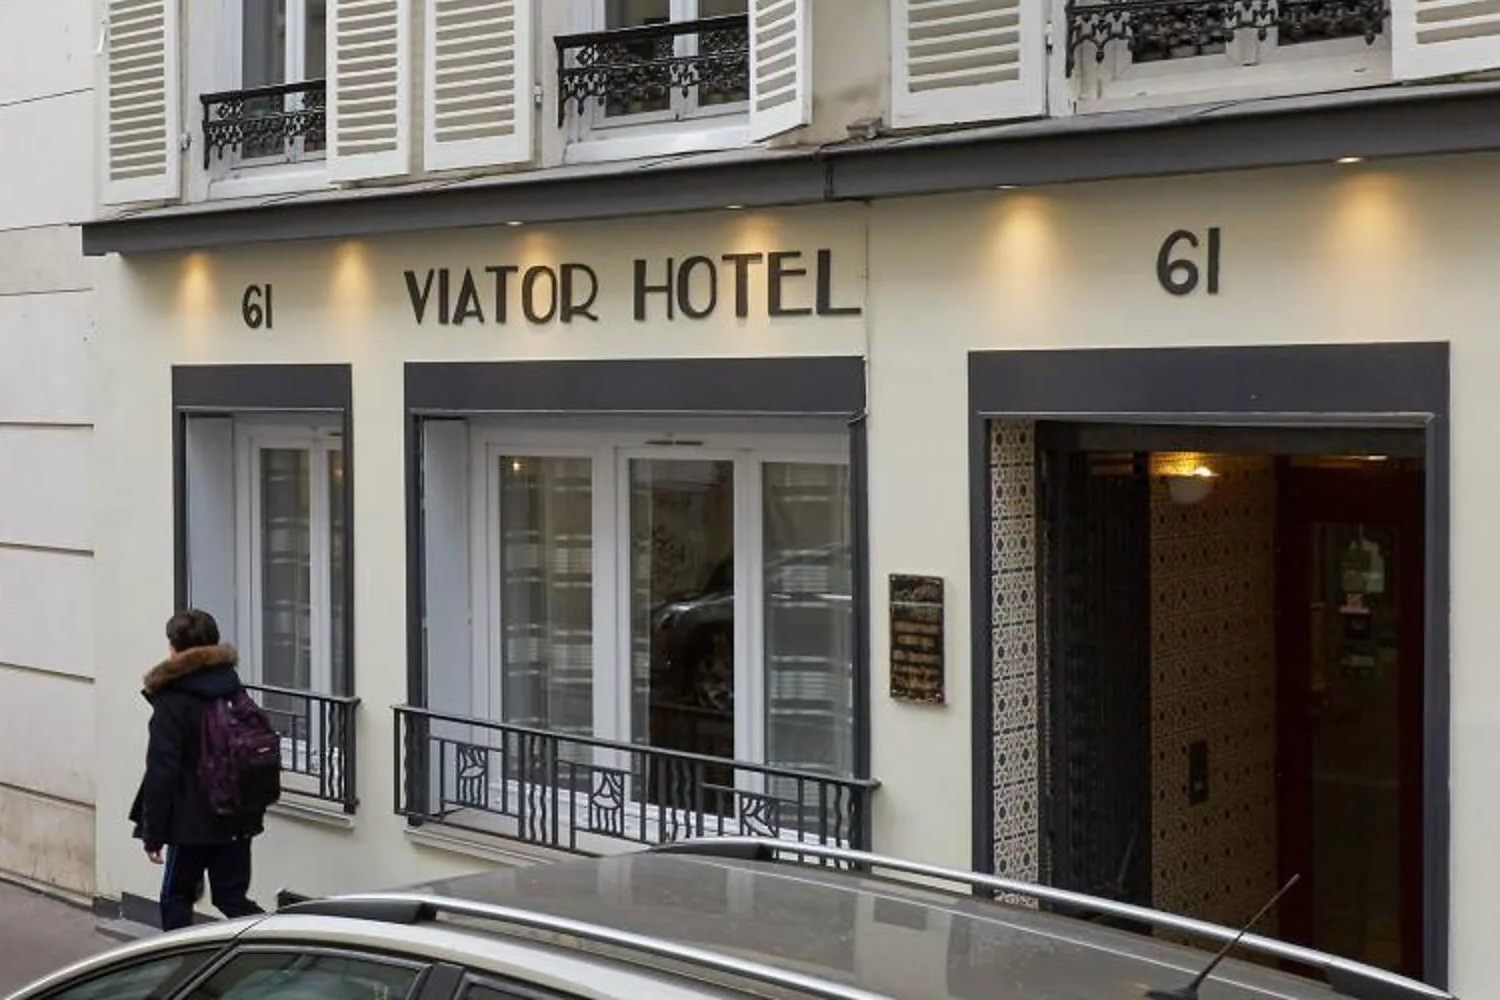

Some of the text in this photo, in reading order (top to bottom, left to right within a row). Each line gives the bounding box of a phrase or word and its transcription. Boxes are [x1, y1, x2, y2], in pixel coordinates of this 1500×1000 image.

[403, 248, 862, 325] VIATOR HOTEL
[1156, 227, 1220, 295] 61
[241, 283, 273, 329] 61
